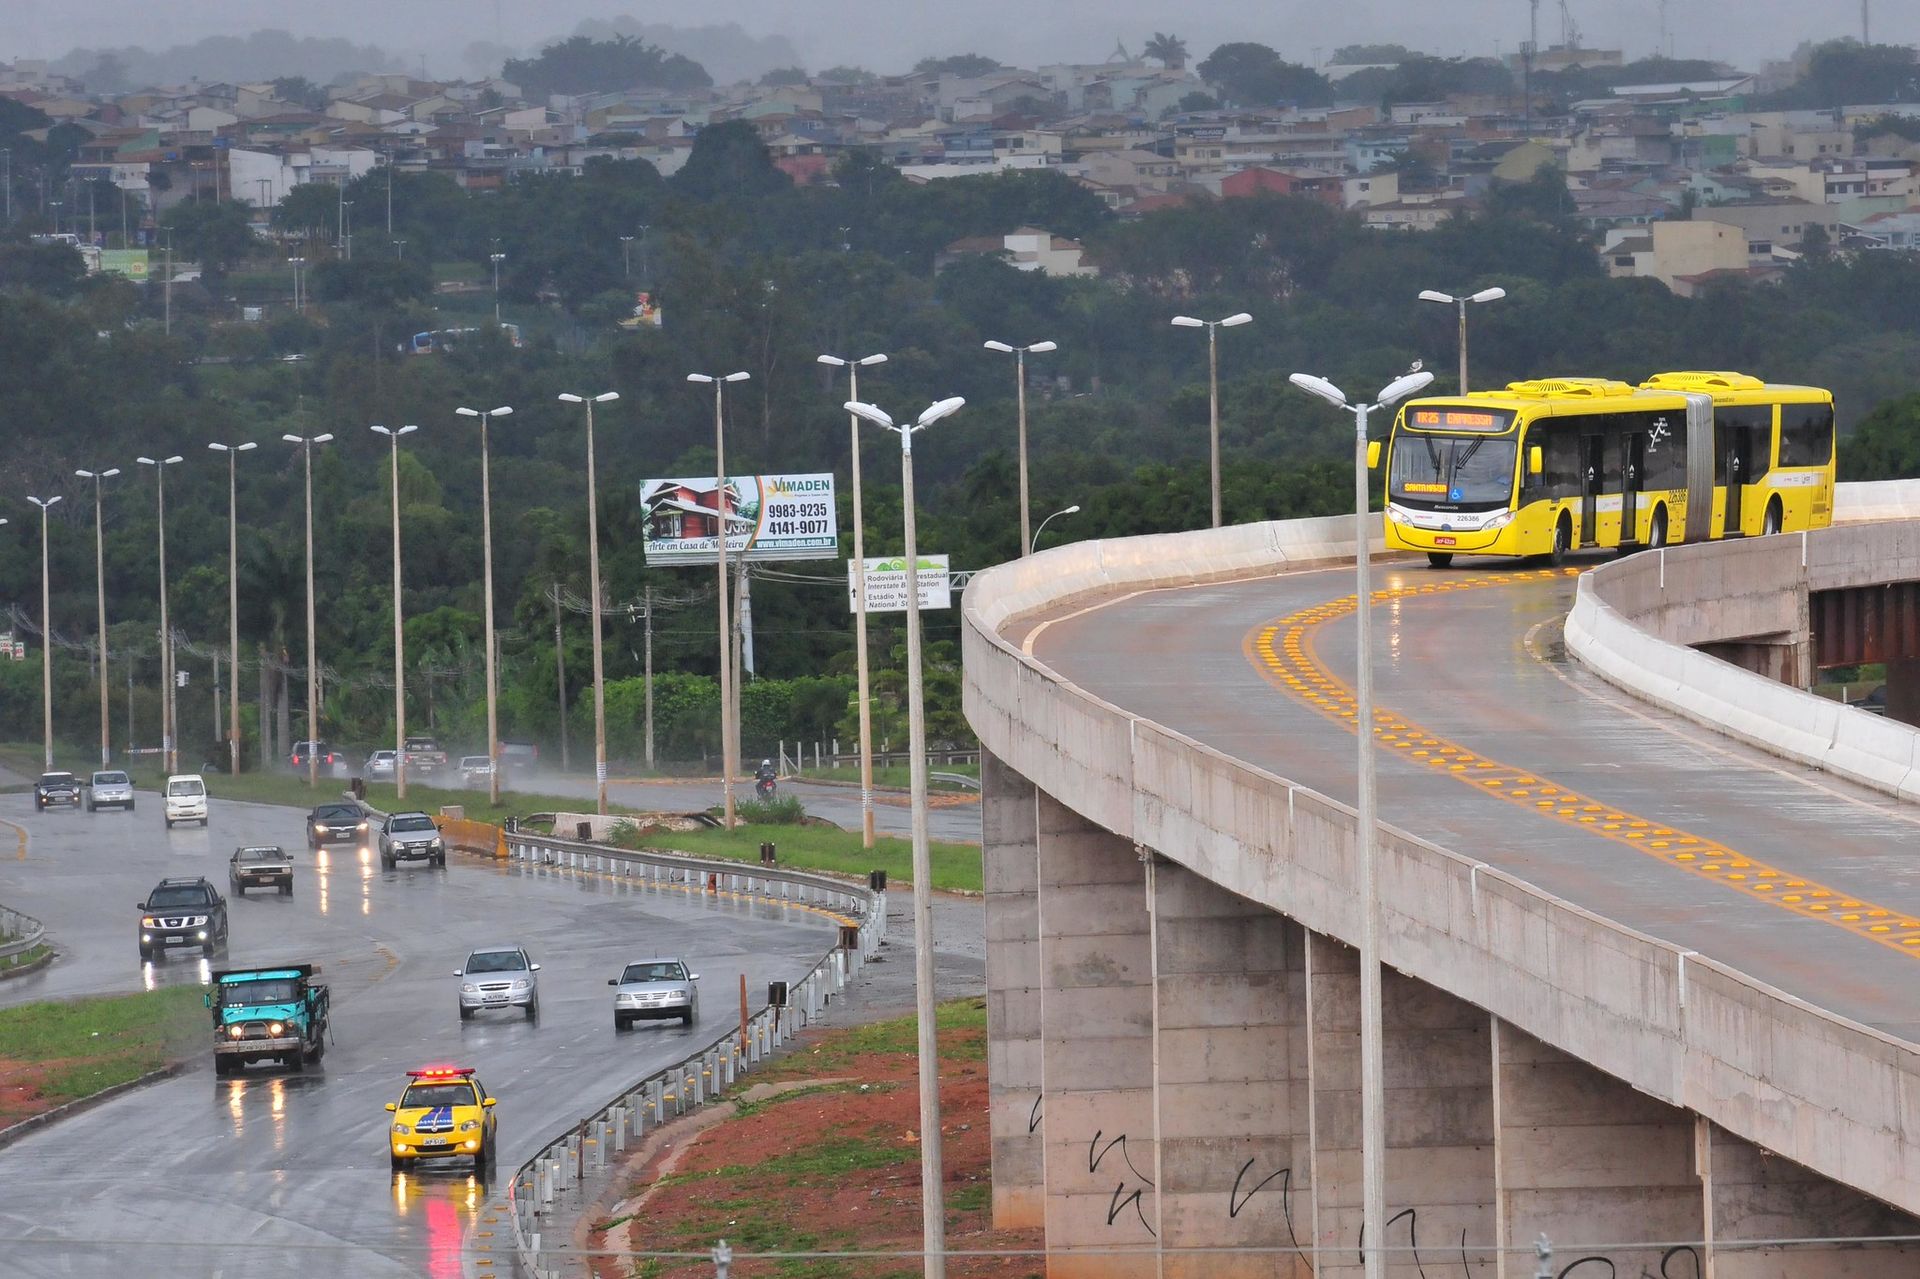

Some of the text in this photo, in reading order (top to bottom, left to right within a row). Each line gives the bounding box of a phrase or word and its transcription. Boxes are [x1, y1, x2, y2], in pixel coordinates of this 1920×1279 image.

[774, 477, 830, 492] VIMADEN
[768, 503, 827, 518] 9983-9235
[769, 520, 828, 535] 4141-9077
[649, 541, 665, 551] Arte
[667, 543, 679, 551] em
[680, 541, 698, 550] Casa
[700, 540, 708, 549] de
[757, 538, 831, 548] www.vimaden.com.br
[867, 572, 948, 582] Rodoviária Irestadual
